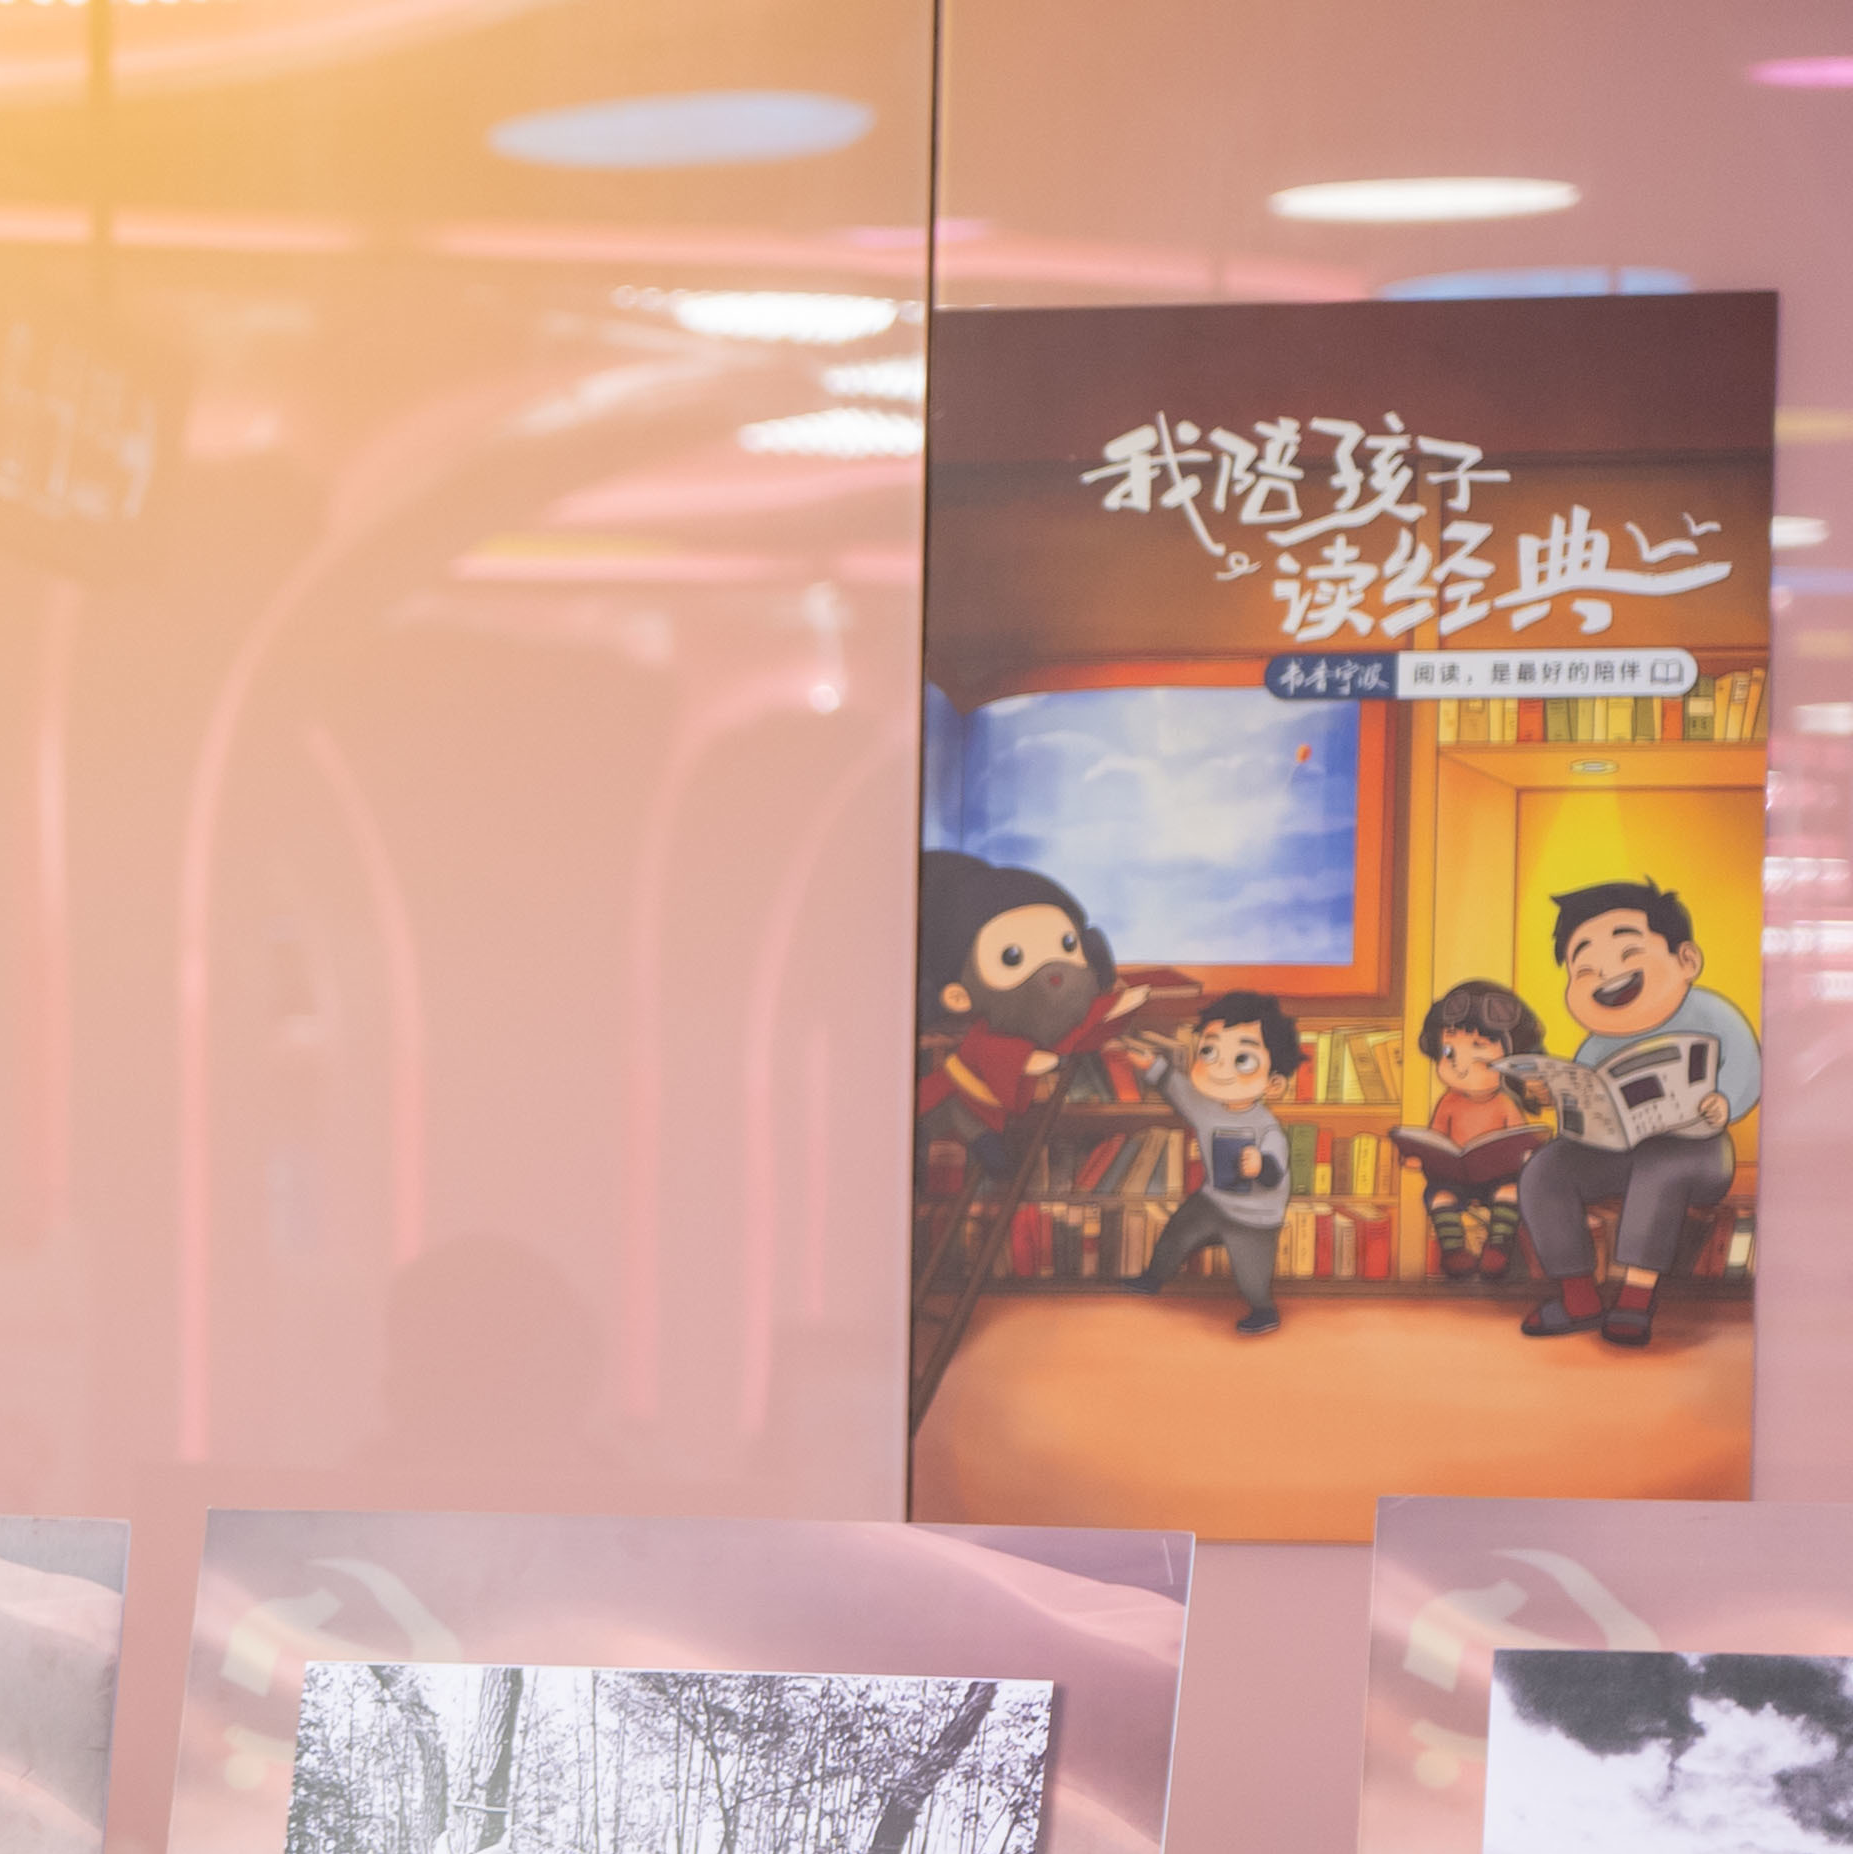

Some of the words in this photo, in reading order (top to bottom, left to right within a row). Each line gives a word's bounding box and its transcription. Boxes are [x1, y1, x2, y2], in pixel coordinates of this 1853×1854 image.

[1081, 411, 1510, 553] 我陪孩子
[1273, 504, 1731, 641] 读经典
[1412, 659, 1642, 686] 阅读，是最好的陪伴
